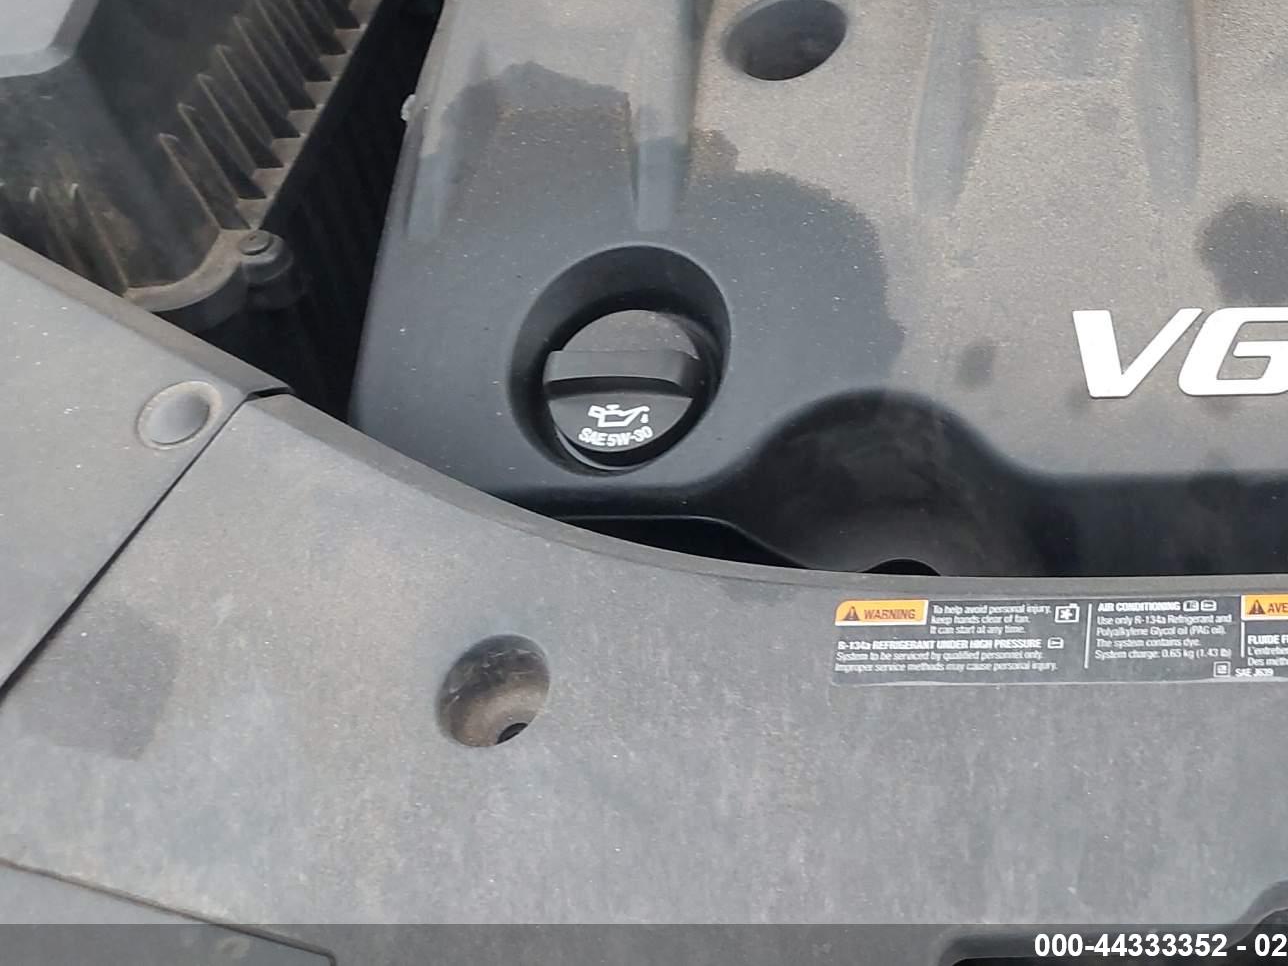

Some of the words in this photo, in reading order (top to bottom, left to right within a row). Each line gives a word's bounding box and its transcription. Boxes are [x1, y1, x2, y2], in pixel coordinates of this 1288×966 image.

[578, 427, 606, 446] SAE
[607, 425, 653, 447] 5W-30
[933, 605, 943, 613] To
[944, 605, 963, 615] help
[964, 605, 987, 613] avoid
[989, 605, 1025, 615] personal
[1098, 603, 1115, 611] AIR
[1115, 602, 1181, 611] CONDITIONING
[864, 609, 915, 619] WARNING
[931, 616, 952, 626] keep
[954, 616, 980, 624] hands
[981, 616, 1002, 624] clear
[1004, 616, 1013, 624] of
[1014, 616, 1030, 624] fan.
[1097, 616, 1114, 625] Use
[1115, 616, 1133, 627] only
[1134, 615, 1166, 624] R-134a
[1167, 615, 1214, 626] Refrigerant
[1215, 615, 1232, 624] and
[930, 626, 936, 634] It
[955, 626, 975, 634] start
[976, 626, 986, 634] at
[987, 626, 1003, 636] any
[1004, 626, 1026, 634] time.
[1096, 627, 1149, 638] Polyalkylene
[1150, 626, 1176, 637] Glycol
[1177, 626, 1188, 635] oil
[1189, 626, 1210, 637] (PAG
[1211, 626, 1227, 637] oil).
[838, 640, 872, 649] R-134a
[872, 640, 936, 649] REFRIGERANT
[936, 640, 969, 649] UNDER
[969, 640, 993, 649] HIGH
[994, 640, 1042, 649] PRESSURE
[1096, 639, 1112, 647] The
[1113, 639, 1144, 649] system
[1145, 638, 1182, 647] contains
[1183, 638, 1201, 649] dye.
[1247, 635, 1281, 644] FLUIDE
[836, 652, 869, 662] System
[869, 652, 879, 660] to
[880, 652, 892, 660] be
[893, 652, 929, 660] serviced
[930, 652, 941, 662] by
[942, 652, 980, 662] qualified
[981, 651, 1023, 662] personnel
[1023, 651, 1042, 662] only.
[835, 663, 873, 673] Improper
[874, 663, 906, 671] service
[907, 663, 944, 671] methods
[945, 663, 965, 673] may
[993, 663, 1030, 672] personal
[1031, 663, 1058, 672] injury.
